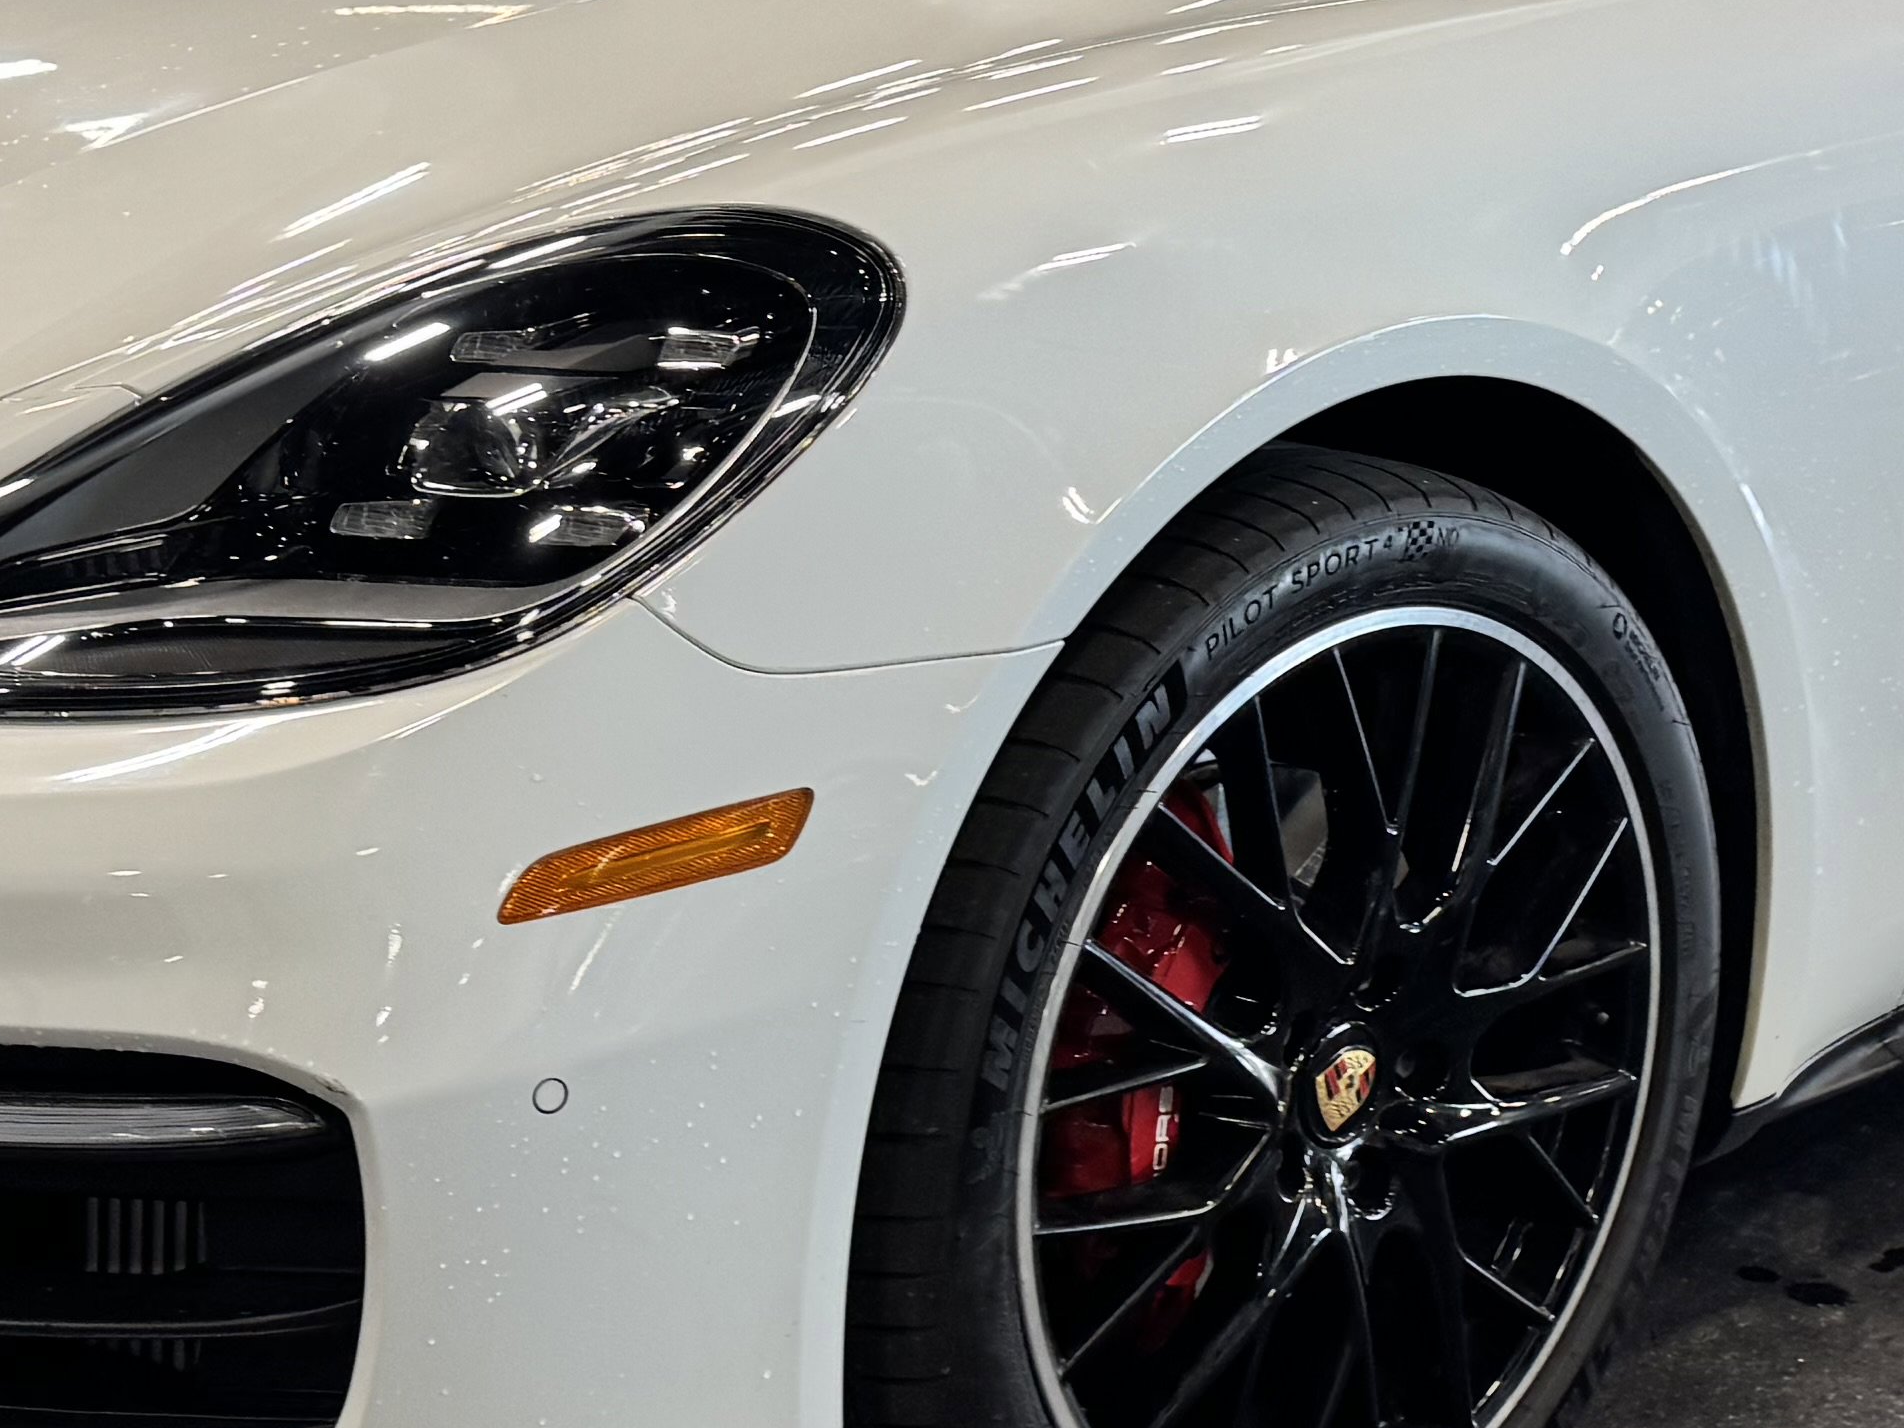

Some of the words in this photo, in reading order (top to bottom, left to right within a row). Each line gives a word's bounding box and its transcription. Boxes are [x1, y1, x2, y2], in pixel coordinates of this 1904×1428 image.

[1204, 585, 1278, 661] PILOT
[1291, 538, 1380, 594] SPORT
[980, 683, 1173, 1093] MICHELIN
